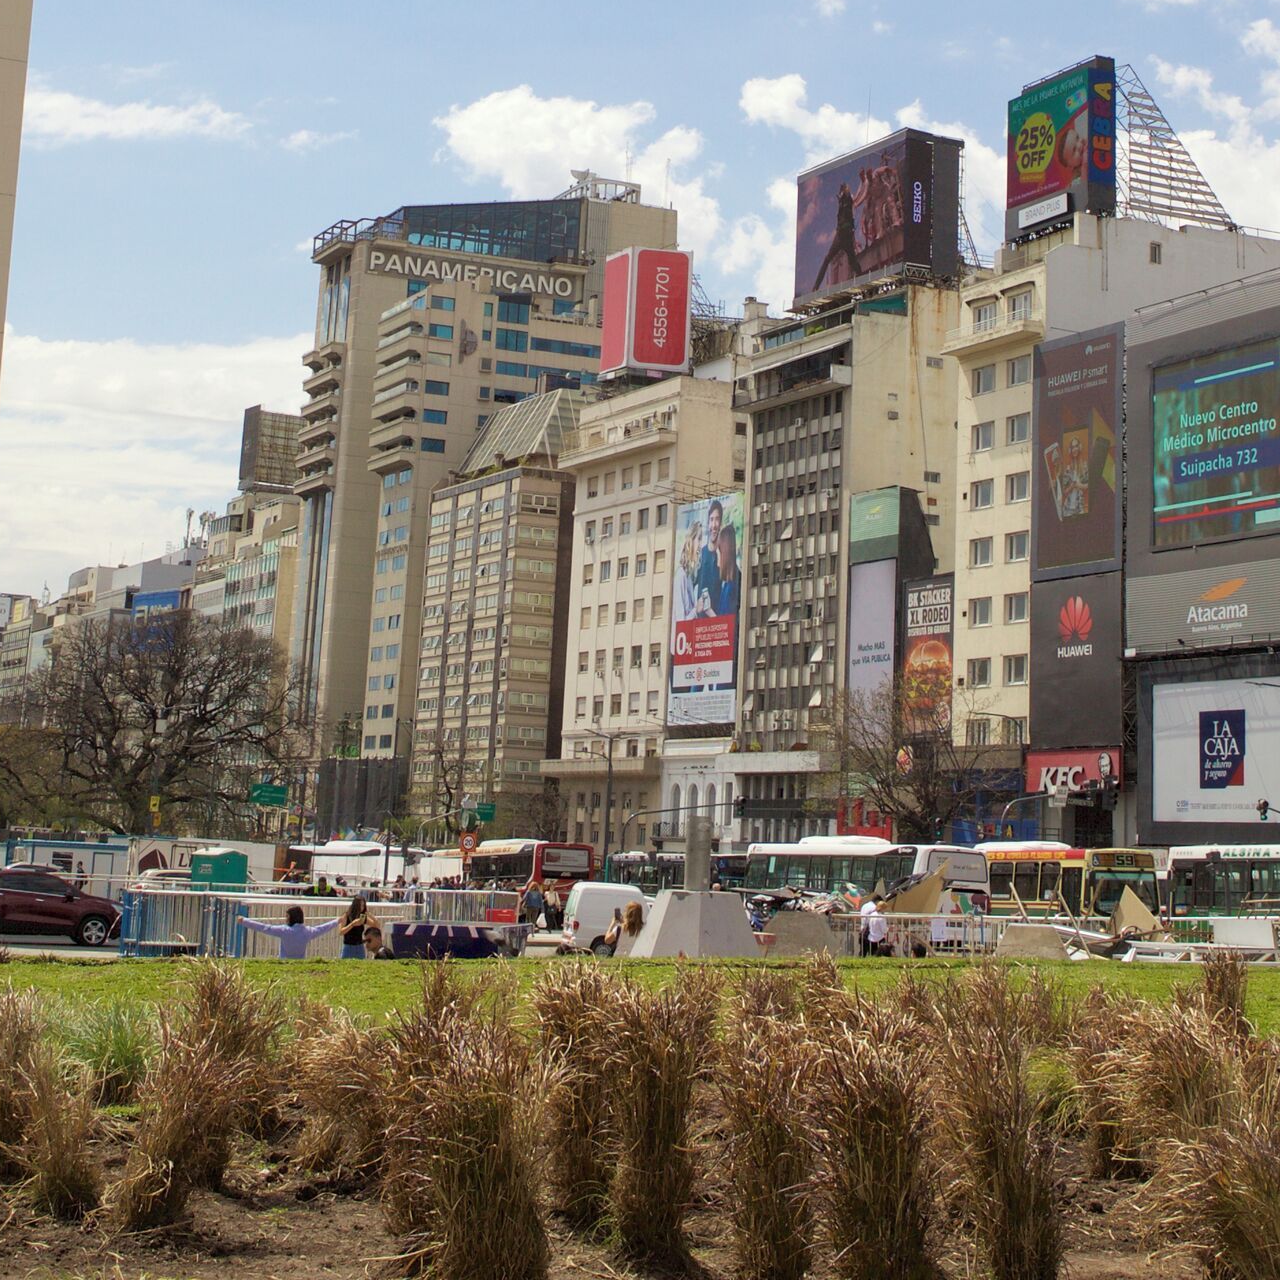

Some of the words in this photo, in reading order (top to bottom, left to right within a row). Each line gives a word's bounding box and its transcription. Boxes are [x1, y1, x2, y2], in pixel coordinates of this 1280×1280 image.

[1093, 82, 1113, 170] CEBRA
[1018, 123, 1054, 152] 25%
[1021, 149, 1047, 170] OFF
[913, 181, 922, 223] SEIKO
[1024, 203, 1045, 221] BRAND
[1046, 199, 1062, 215] PLUS
[370, 251, 573, 297] PANAMERICANO
[653, 266, 670, 348] 4556-1701
[1047, 370, 1081, 388] HUAWEI
[1088, 364, 1108, 378] smart
[1180, 411, 1215, 428] Nuevo
[1220, 401, 1258, 420] Centro
[1163, 433, 1204, 452] Médico
[1207, 418, 1277, 443] Microcentro
[1180, 454, 1233, 477] Suipacha
[1237, 448, 1258, 466] 732
[908, 592, 919, 608] BK
[920, 588, 951, 607] STACKER
[909, 610, 920, 625] XL
[922, 606, 949, 624] RODEO
[1186, 603, 1248, 624] Atacama
[676, 632, 693, 655] 0%
[857, 642, 873, 652] Mucho
[1057, 644, 1093, 658] HUAWEI
[852, 657, 861, 666] que
[1213, 720, 1232, 738] LA
[1204, 738, 1240, 760] CAJA
[1205, 759, 1212, 769] de
[1039, 766, 1083, 792] KFC
[1209, 770, 1227, 780] seguro
[464, 838, 474, 848] 20
[1223, 847, 1271, 857] ALSINA
[1115, 855, 1134, 866] 59
